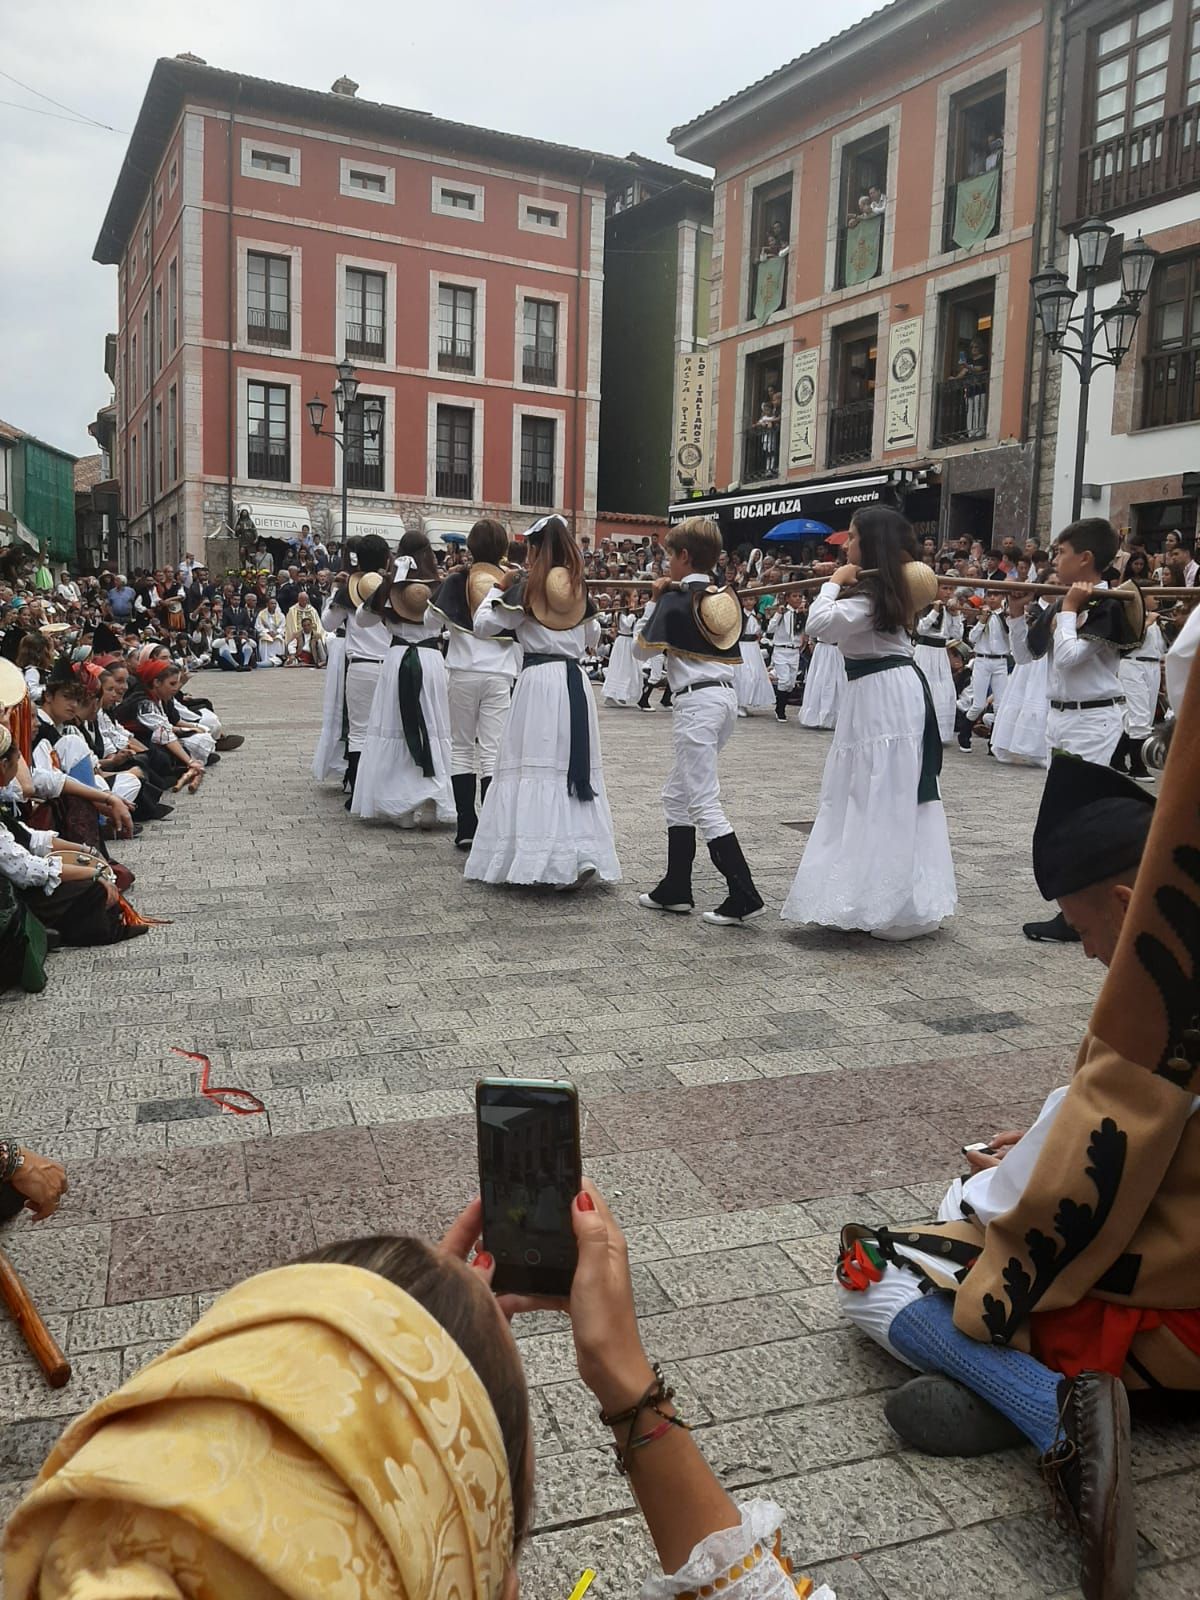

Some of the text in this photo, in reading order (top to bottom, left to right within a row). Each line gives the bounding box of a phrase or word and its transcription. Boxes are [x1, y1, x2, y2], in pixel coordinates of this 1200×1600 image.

[680, 357, 691, 441] PASTA PIZZA
[693, 357, 705, 443] LOS ITALIANOS
[835, 490, 879, 505] cervecería
[1162, 483, 1169, 496] 6
[733, 499, 802, 520] BOCAPLAZA
[254, 517, 298, 530] DIETETICA
